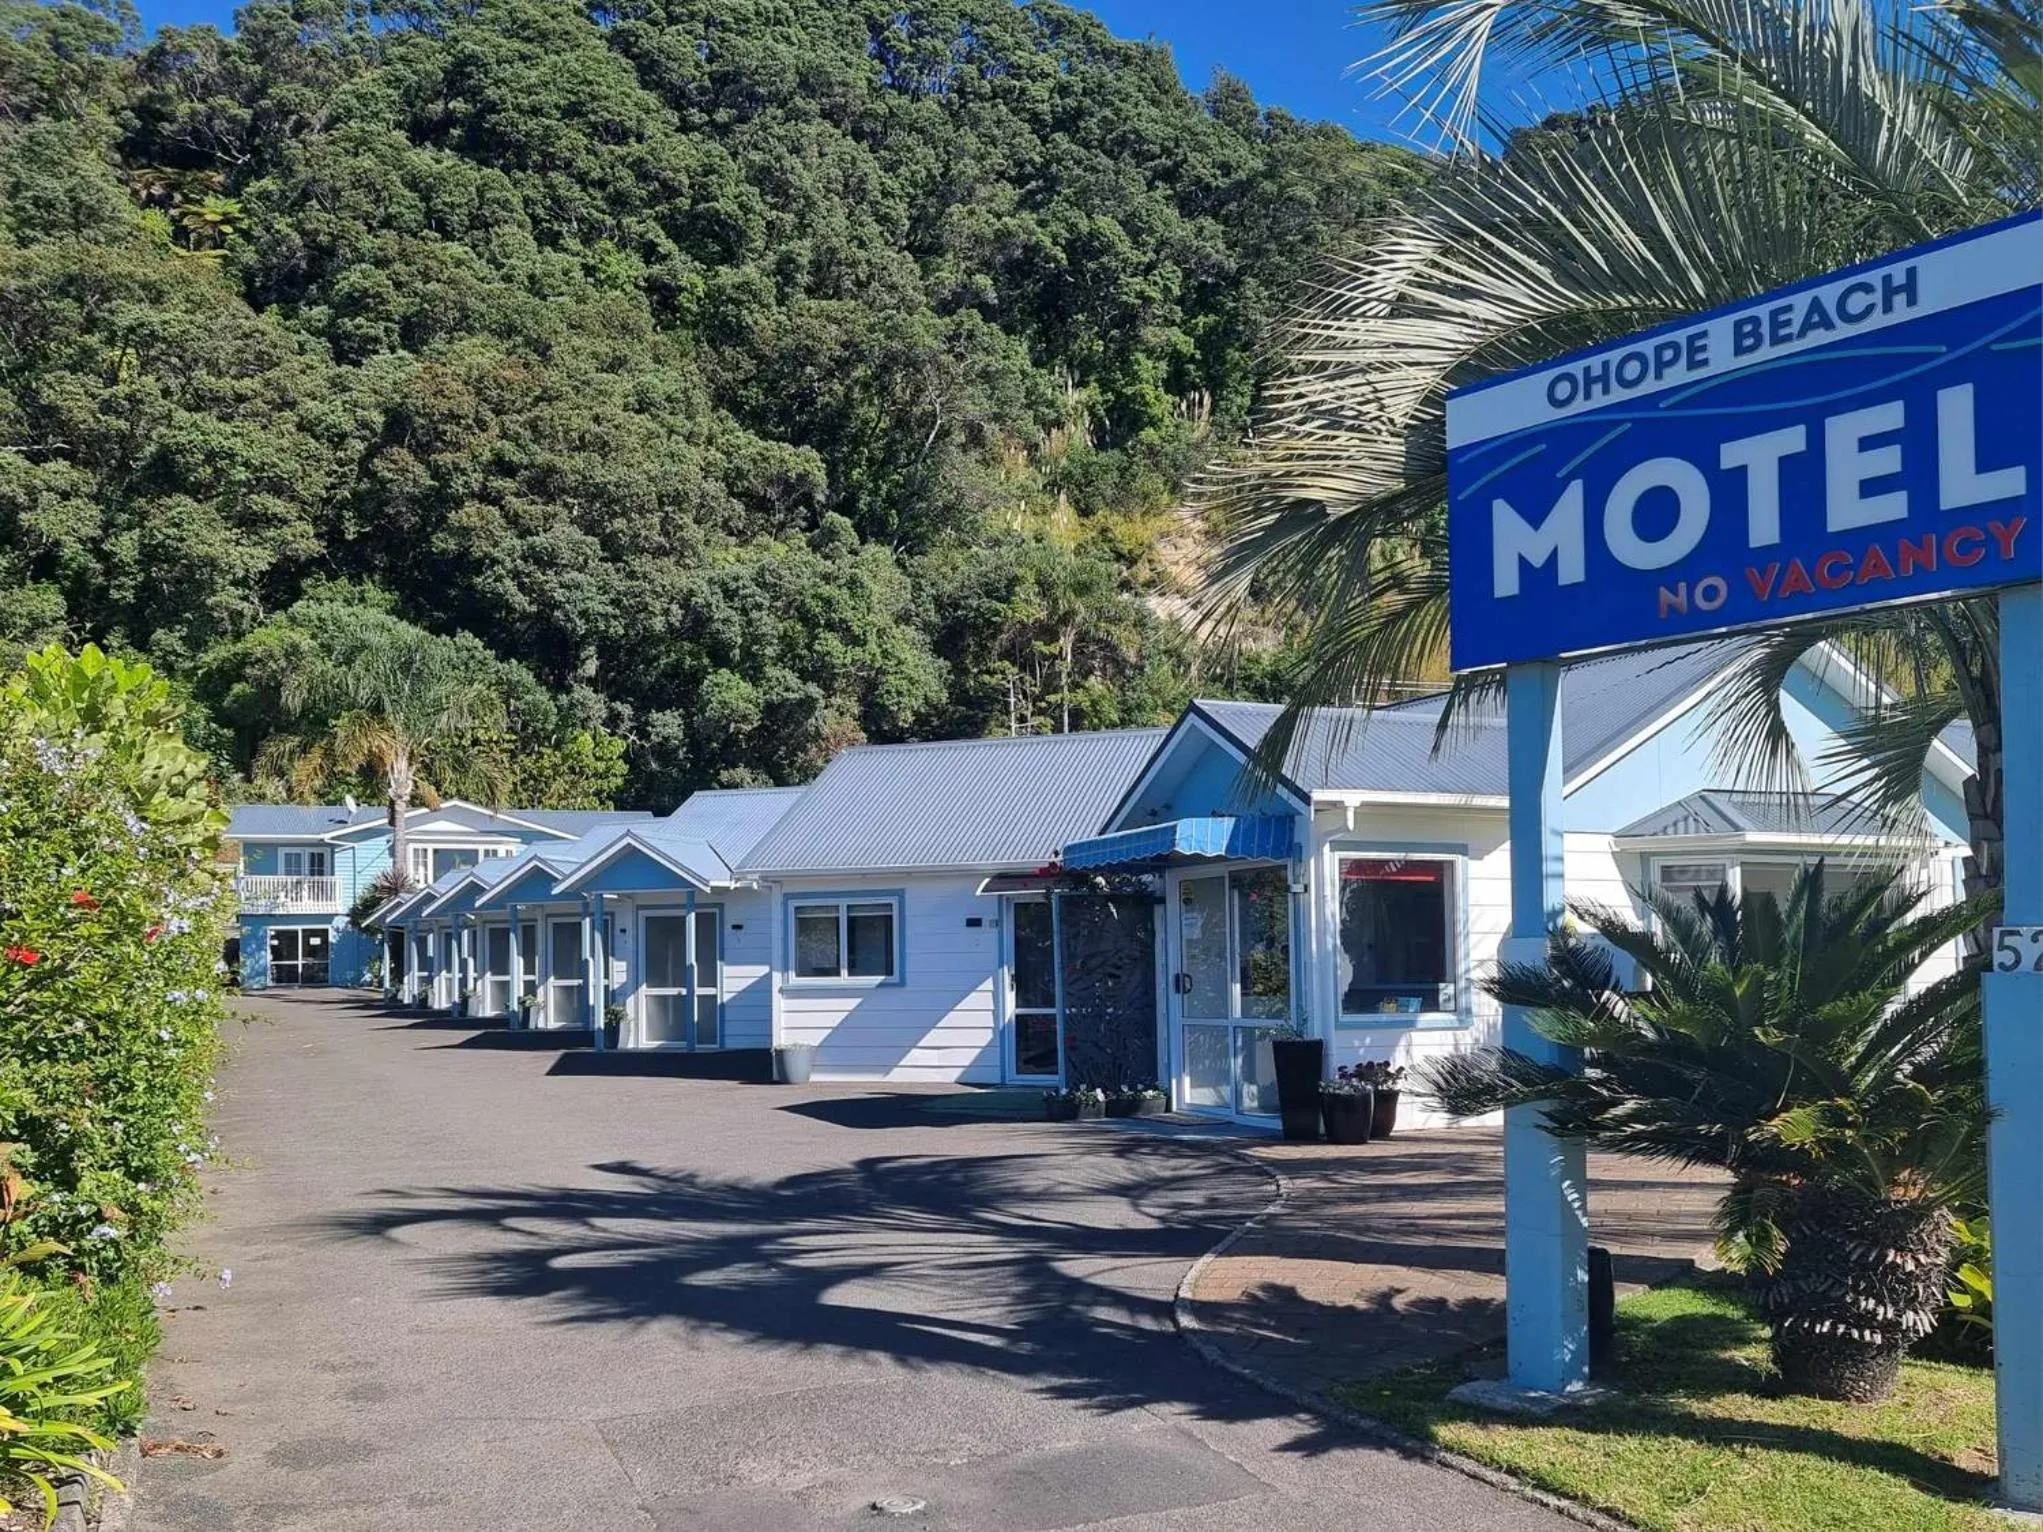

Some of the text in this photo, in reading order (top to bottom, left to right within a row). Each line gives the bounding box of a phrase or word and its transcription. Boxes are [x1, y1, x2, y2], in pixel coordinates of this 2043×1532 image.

[1546, 266, 1919, 409] OHOPE BEACH
[1493, 382, 2027, 599] MOTEL
[1659, 516, 2027, 619] NO VACANCY
